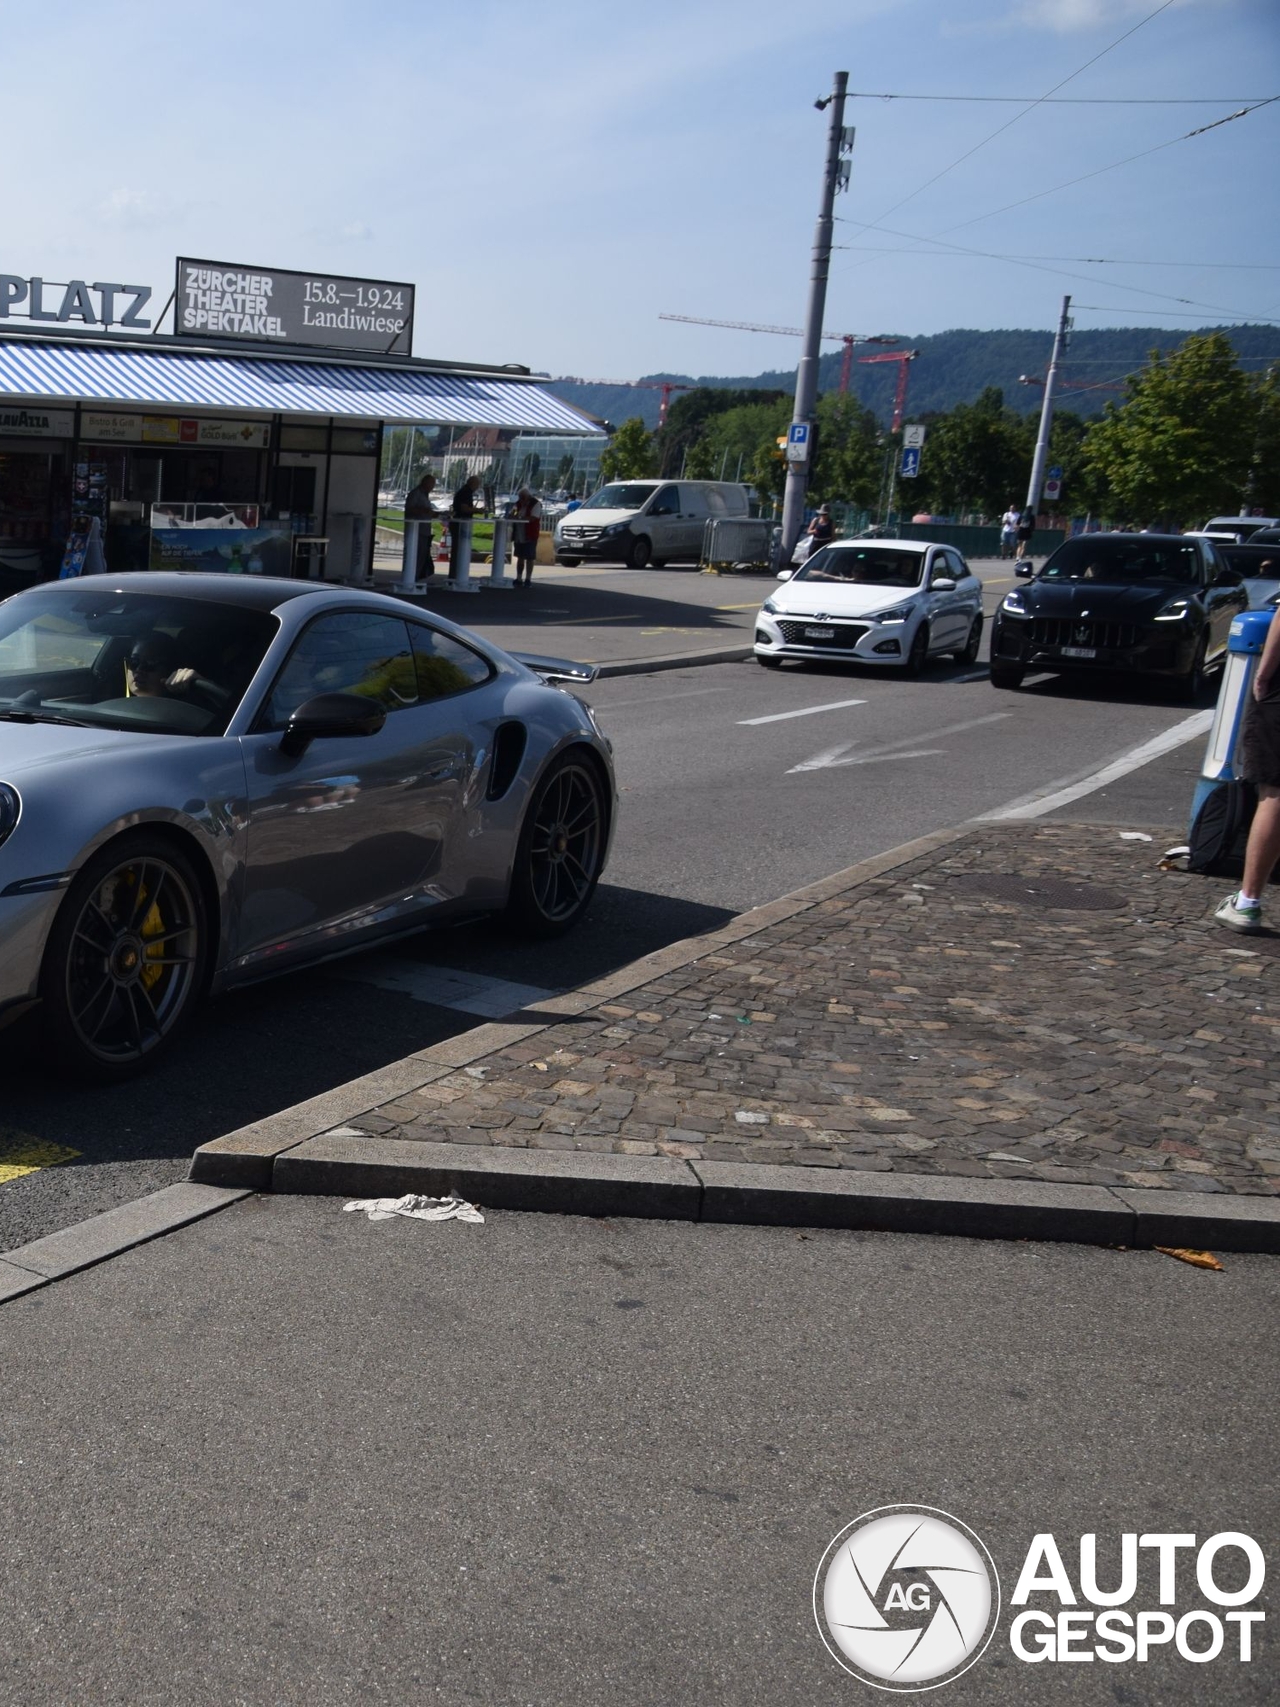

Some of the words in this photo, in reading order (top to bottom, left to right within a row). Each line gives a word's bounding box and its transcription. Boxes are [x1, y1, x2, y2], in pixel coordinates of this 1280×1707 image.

[186, 268, 273, 296] ZÜRCHER
[185, 288, 268, 316] THEATER
[183, 308, 287, 337] SPEKTAKEL
[302, 306, 404, 334] Landiwiese
[89, 416, 111, 426] Bistro
[794, 427, 804, 442] P
